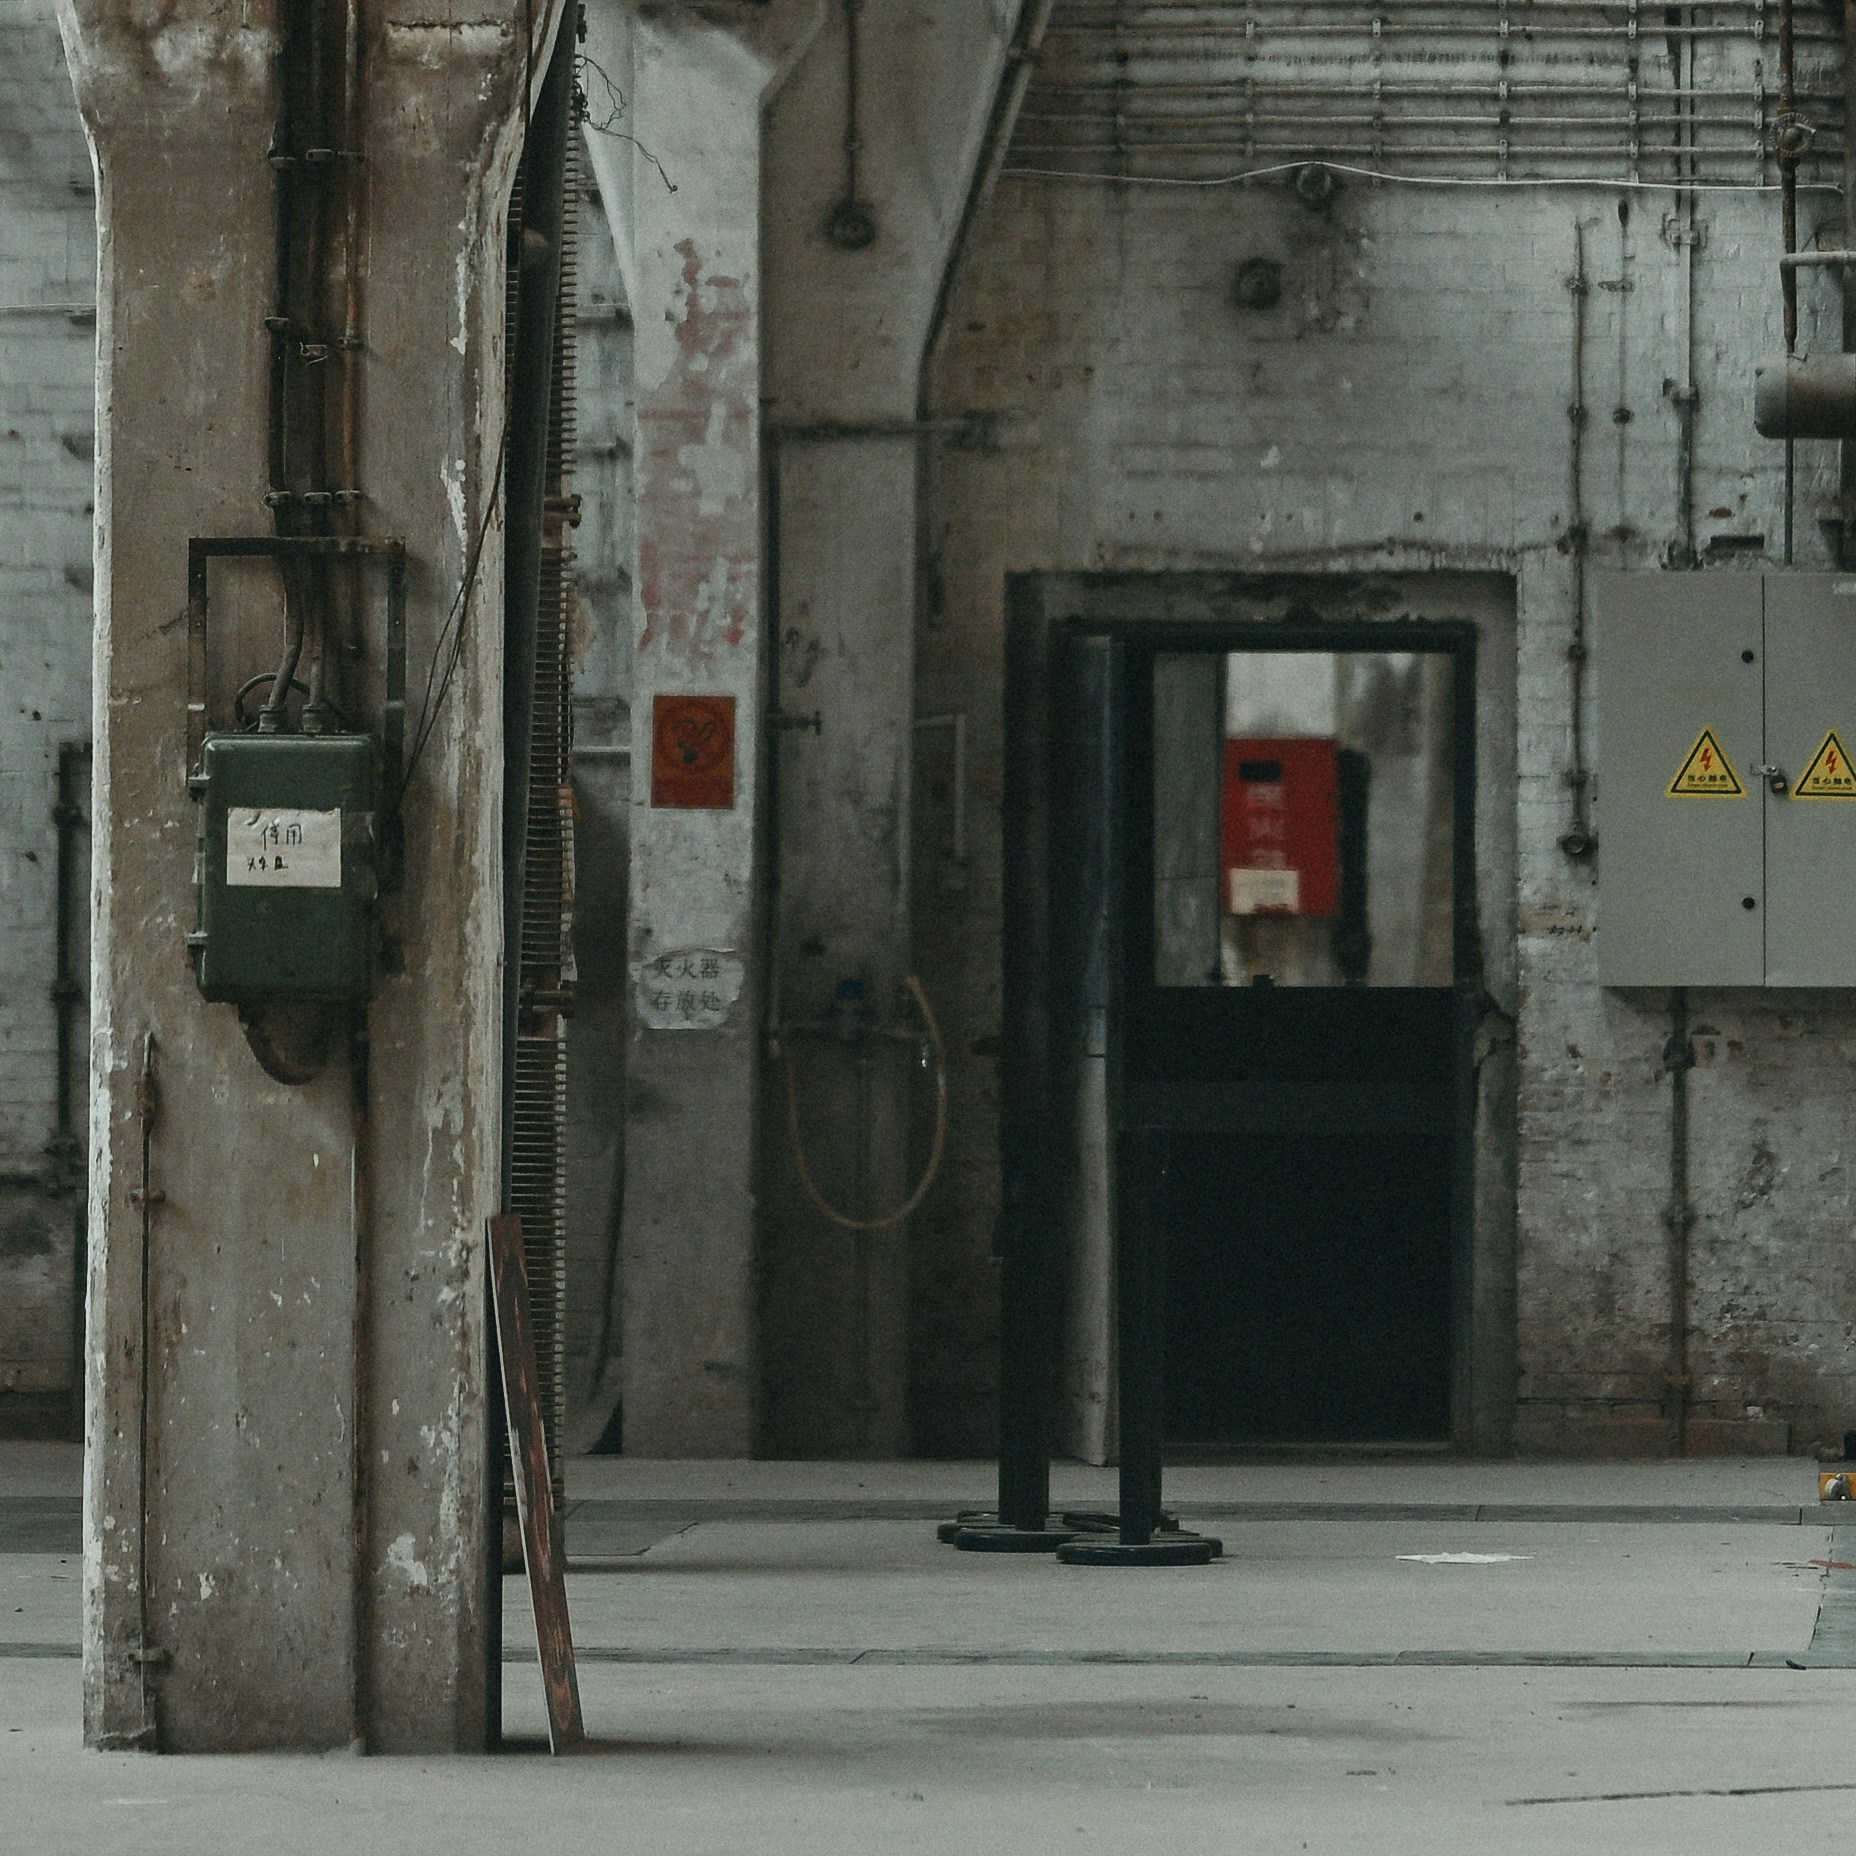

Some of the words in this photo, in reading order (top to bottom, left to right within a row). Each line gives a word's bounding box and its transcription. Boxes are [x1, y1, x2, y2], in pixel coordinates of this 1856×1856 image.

[651, 958, 719, 979] 灭火器
[651, 990, 720, 1013] 存放处
